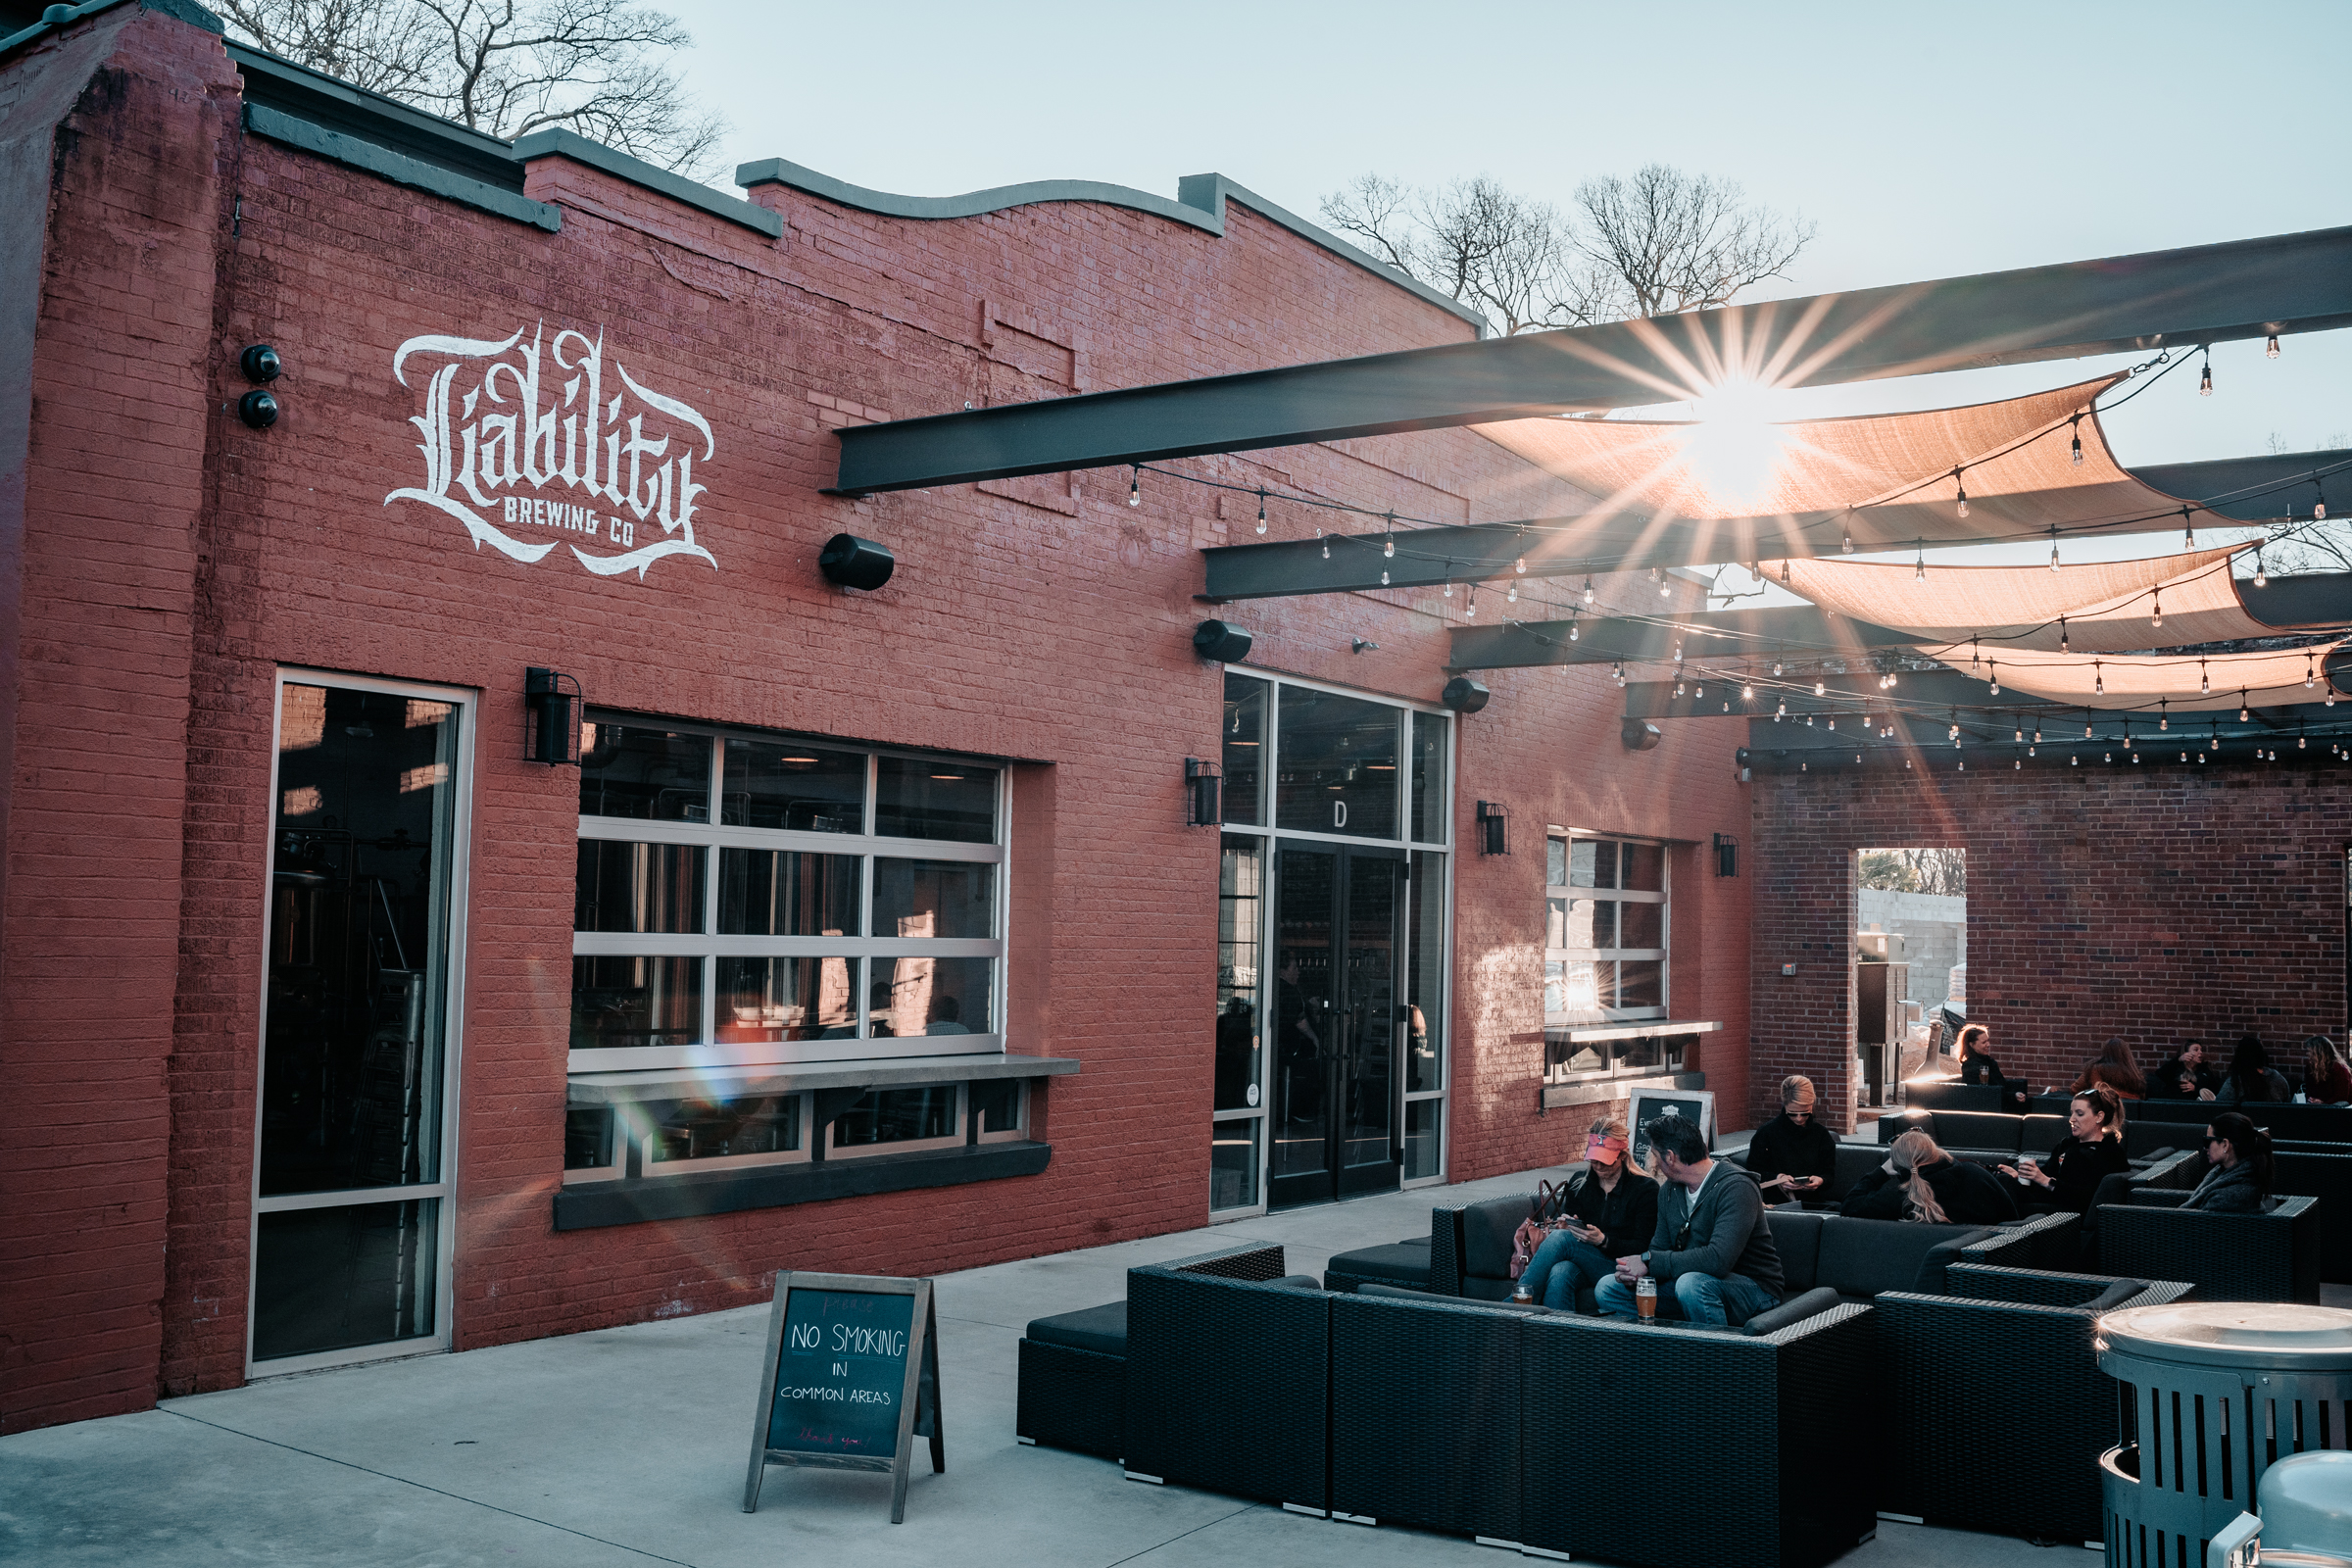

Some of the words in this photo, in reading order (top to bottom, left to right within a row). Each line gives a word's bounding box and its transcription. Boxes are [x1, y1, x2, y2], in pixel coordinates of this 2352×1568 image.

[504, 496, 600, 535] BREWING
[610, 515, 634, 548] CO
[1334, 800, 1348, 828] D
[791, 1323, 820, 1348] NO
[831, 1323, 906, 1357] SMOKING
[832, 1361, 848, 1377] IN
[780, 1386, 844, 1401] COMMON
[849, 1389, 891, 1405] AREAS
